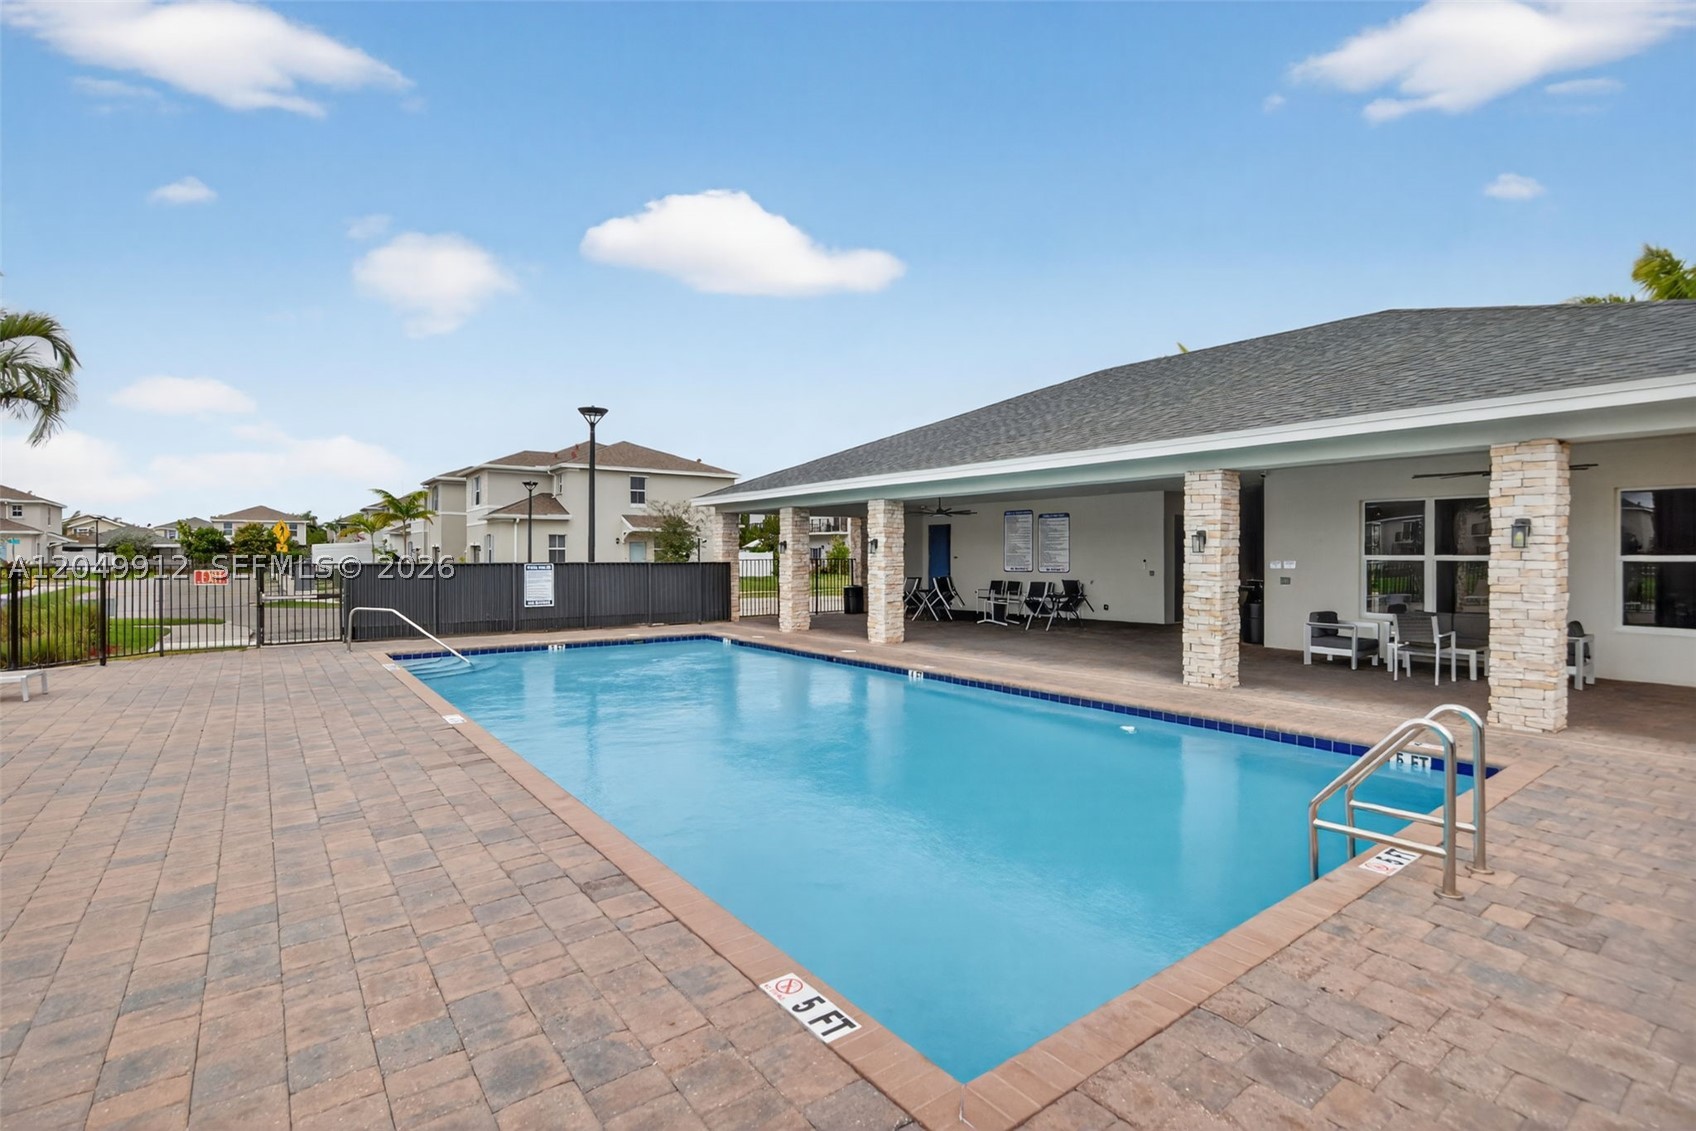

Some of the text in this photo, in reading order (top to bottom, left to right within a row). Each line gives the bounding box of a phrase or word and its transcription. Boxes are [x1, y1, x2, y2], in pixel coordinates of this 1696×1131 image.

[1411, 755, 1429, 768] FT
[1384, 848, 1417, 861] FT
[791, 995, 857, 1037] 5 FT
